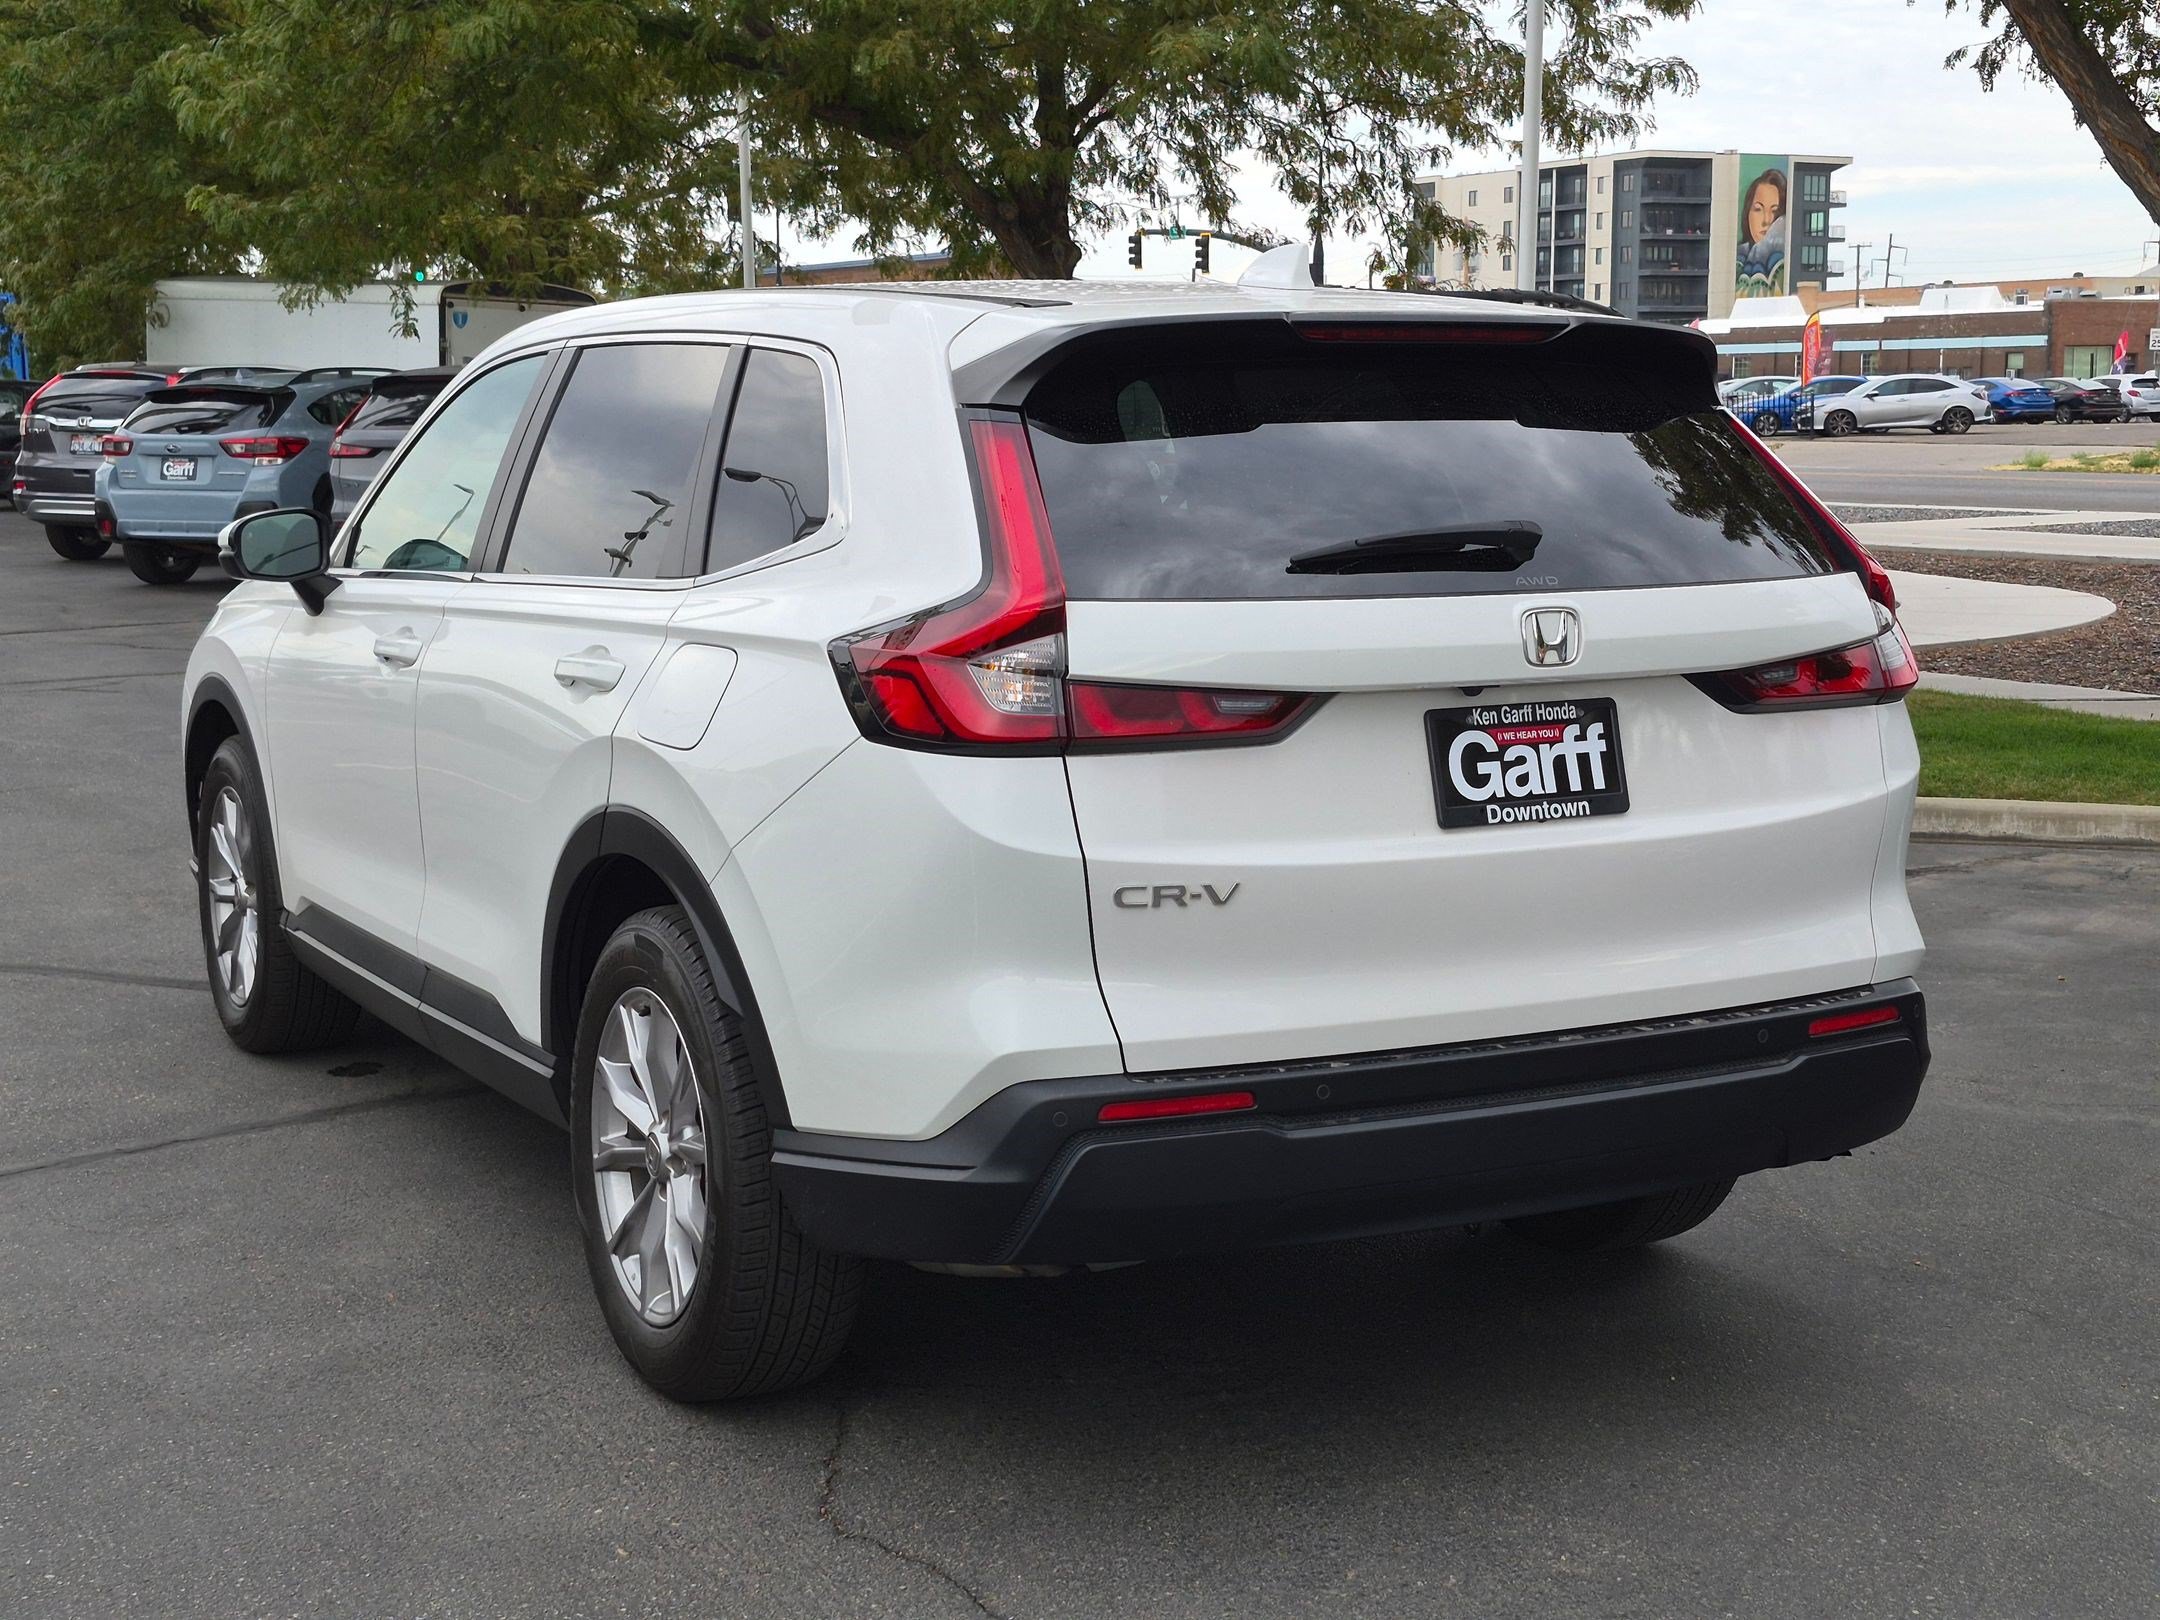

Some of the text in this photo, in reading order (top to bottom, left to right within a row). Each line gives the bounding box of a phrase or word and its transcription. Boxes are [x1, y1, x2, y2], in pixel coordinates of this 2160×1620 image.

[163, 461, 195, 477] Garff
[1515, 575, 1559, 586] AWD
[1472, 702, 1577, 726] Ken Garff Honda
[1503, 729, 1555, 741] WE HEAR YOU
[1448, 722, 1607, 801] Garff
[1486, 800, 1591, 824] Downtown
[1113, 881, 1241, 909] CR-V
